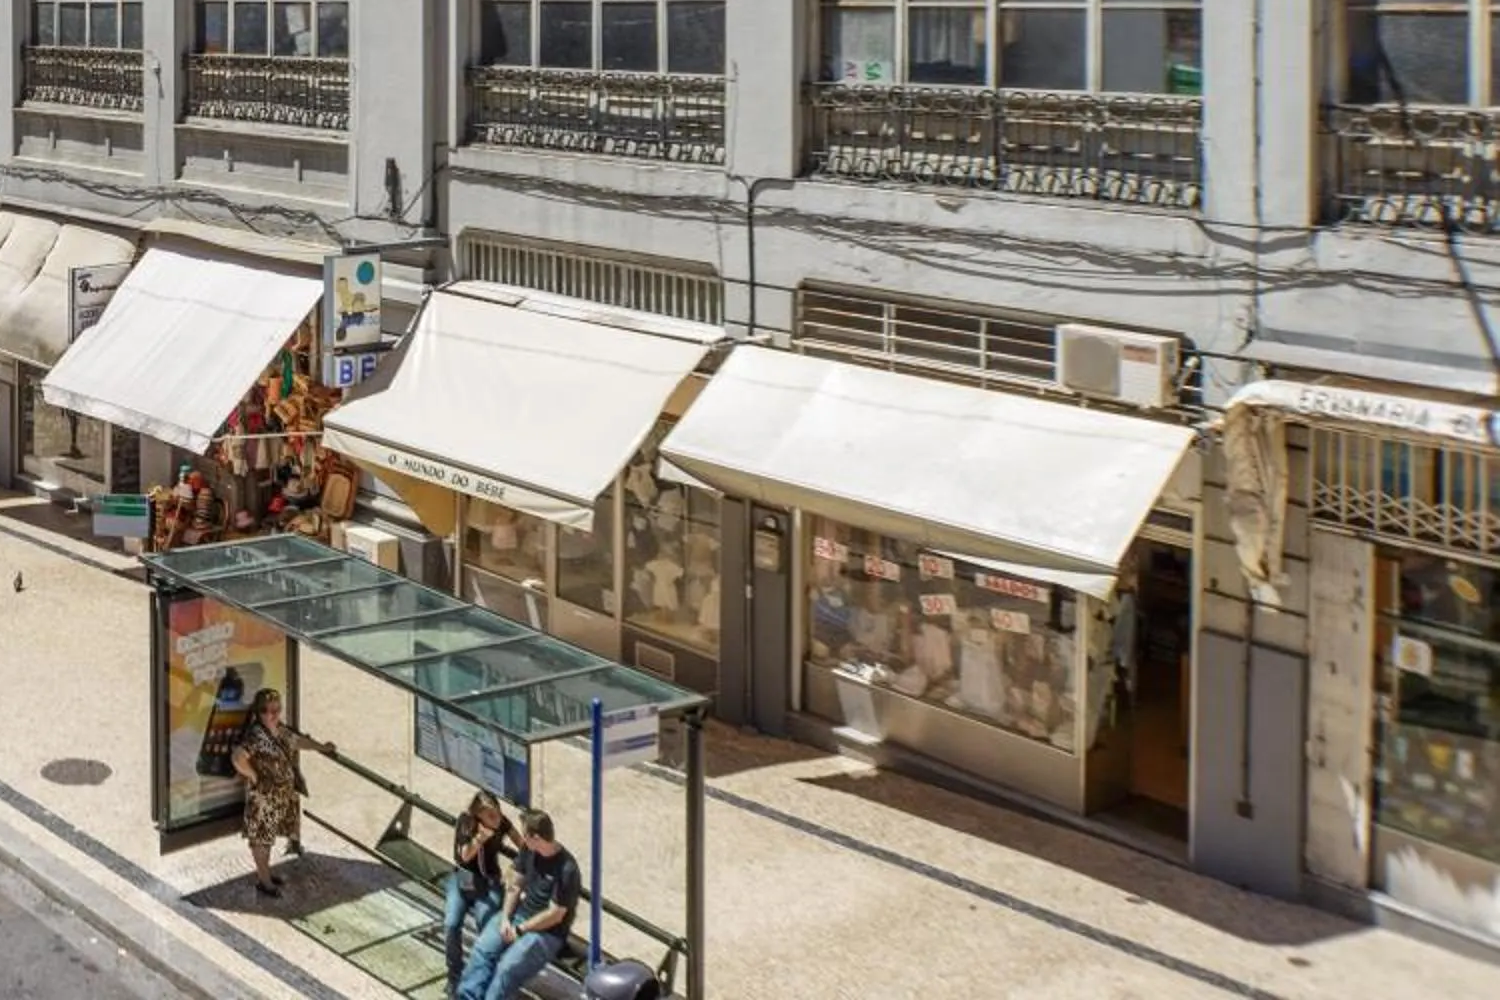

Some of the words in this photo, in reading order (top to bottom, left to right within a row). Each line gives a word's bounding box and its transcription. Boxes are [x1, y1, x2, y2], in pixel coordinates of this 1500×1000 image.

[387, 453, 397, 465] O
[404, 459, 445, 480] MUNDO
[451, 473, 469, 488] DO
